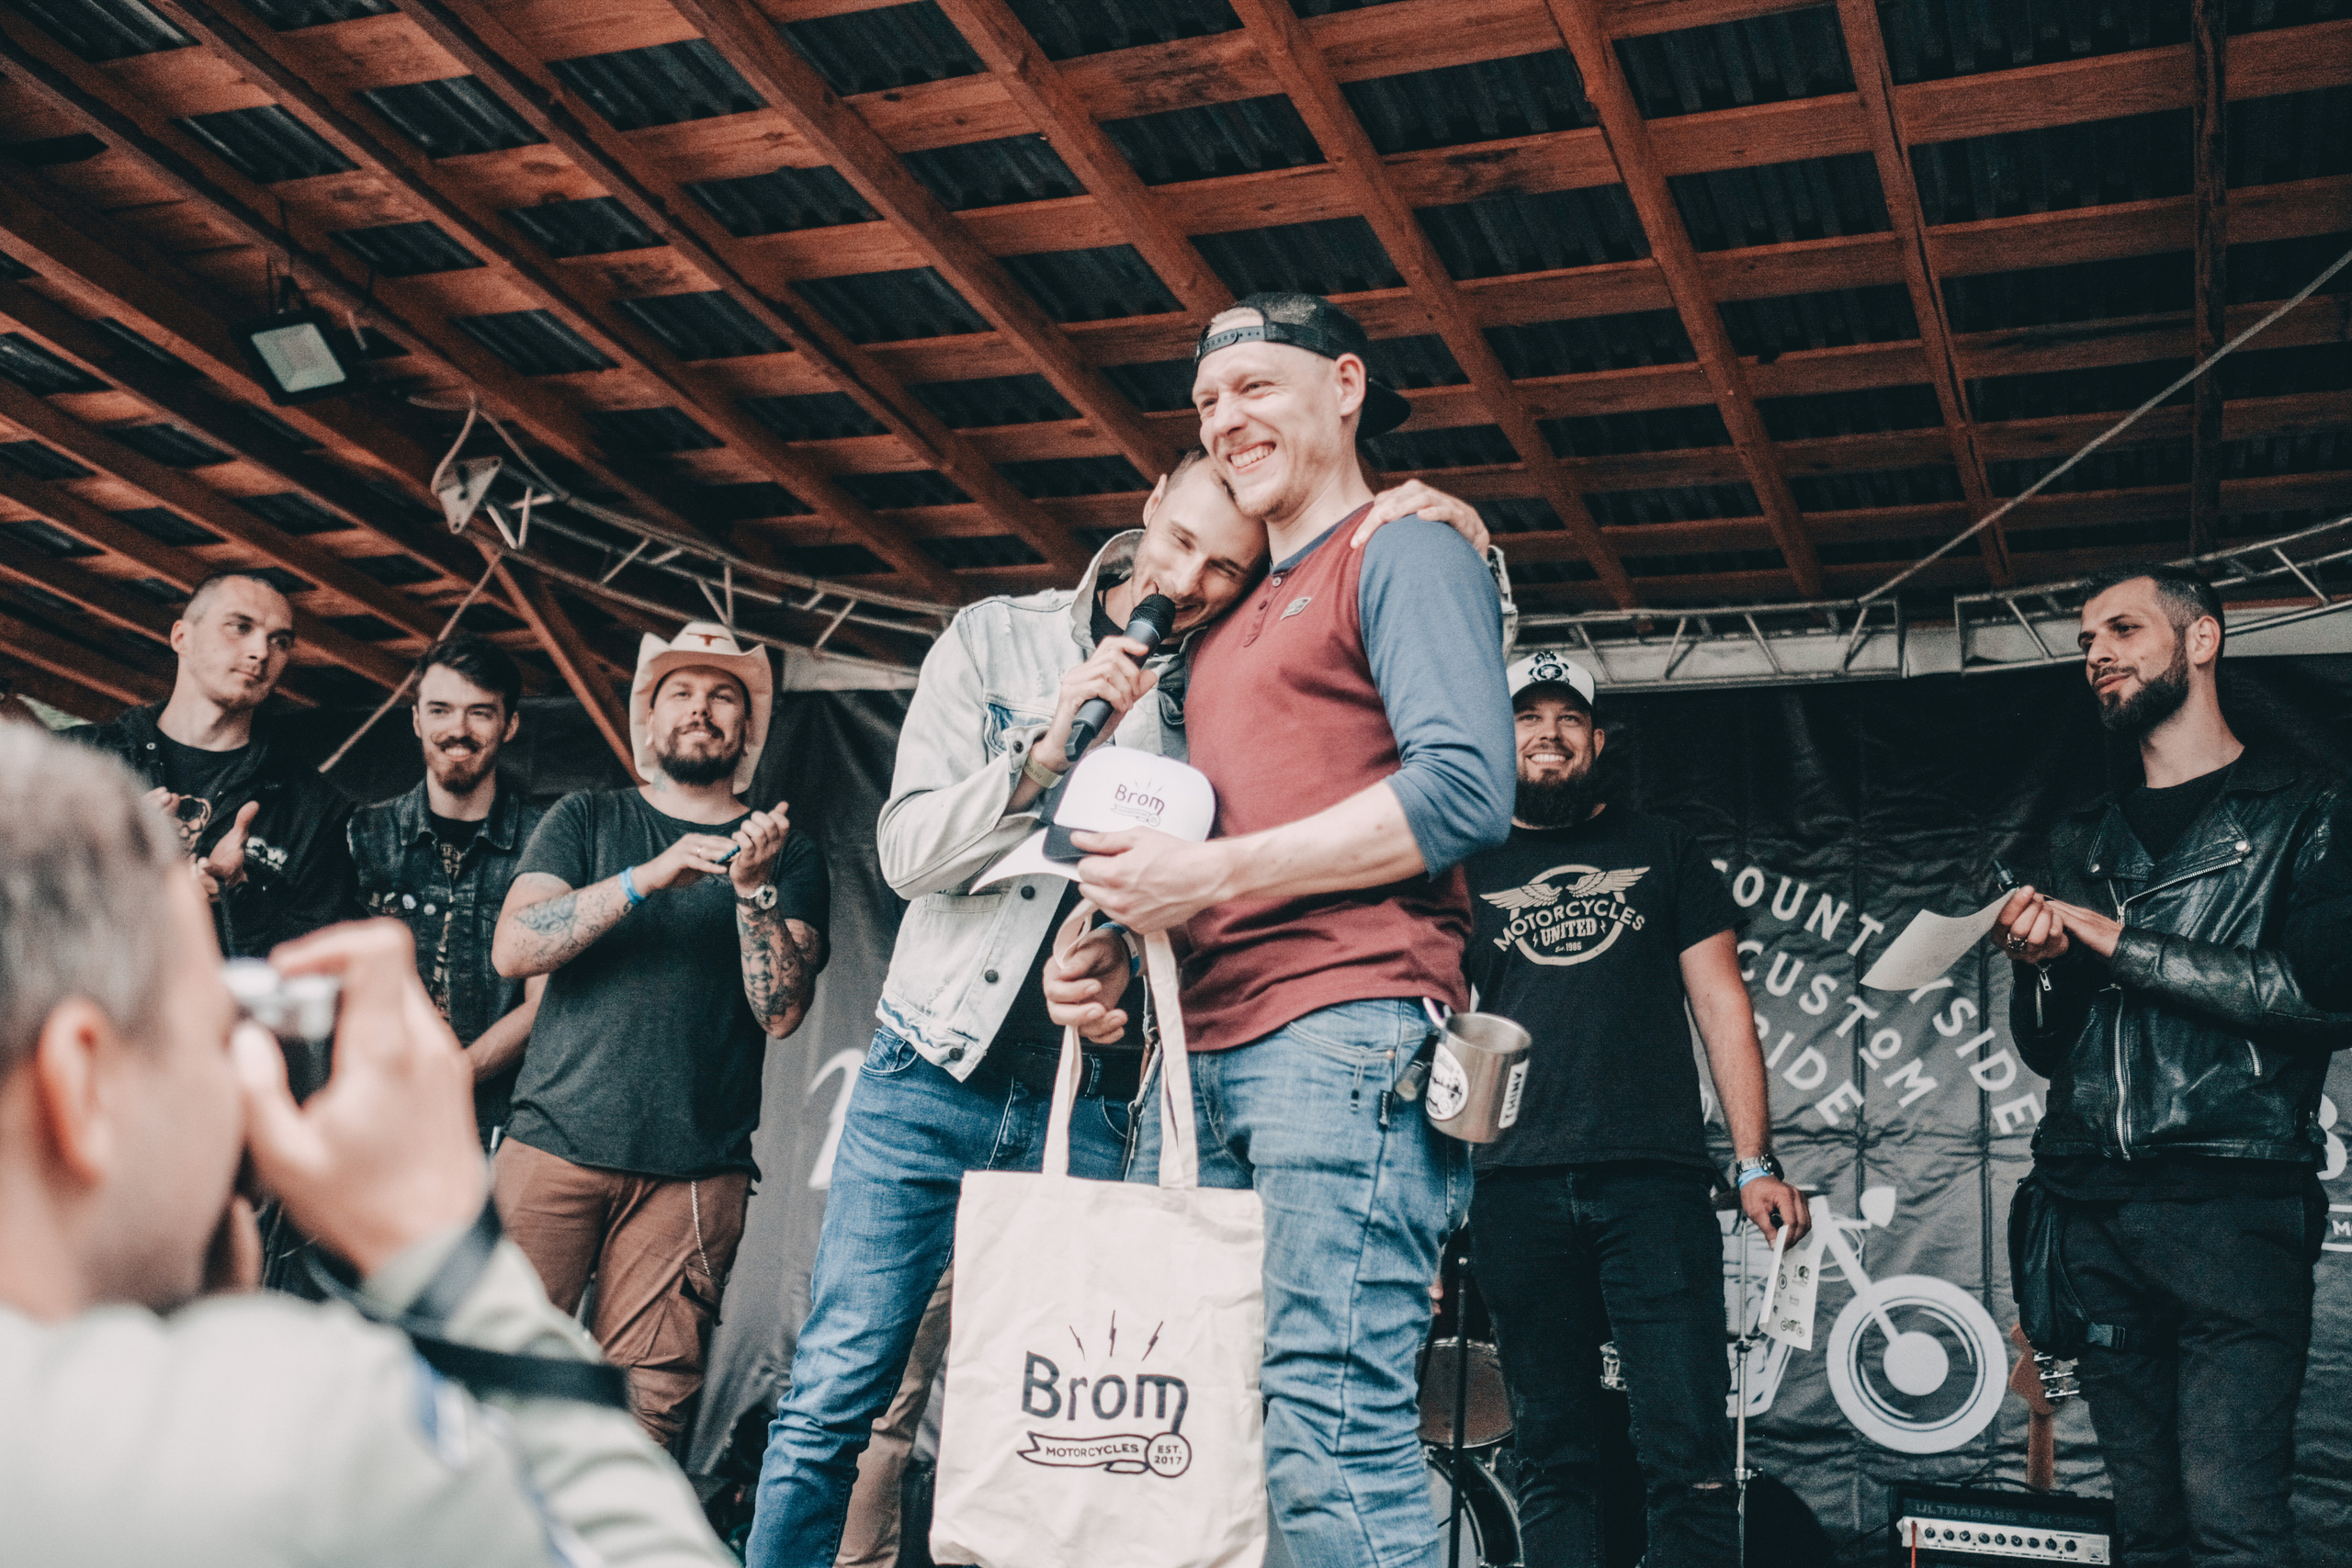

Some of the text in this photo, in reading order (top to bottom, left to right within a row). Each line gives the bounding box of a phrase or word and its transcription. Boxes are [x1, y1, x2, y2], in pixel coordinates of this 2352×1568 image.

[1114, 784, 1165, 816] Brom
[1493, 899, 1645, 952] MOTORCYCLES
[1540, 918, 1597, 946] UNITED
[1022, 1350, 1189, 1434] Brom
[1046, 1443, 1139, 1458] MOTORCYCLES
[1153, 1455, 1182, 1465] 2017
[1157, 1444, 1182, 1454] EST.
